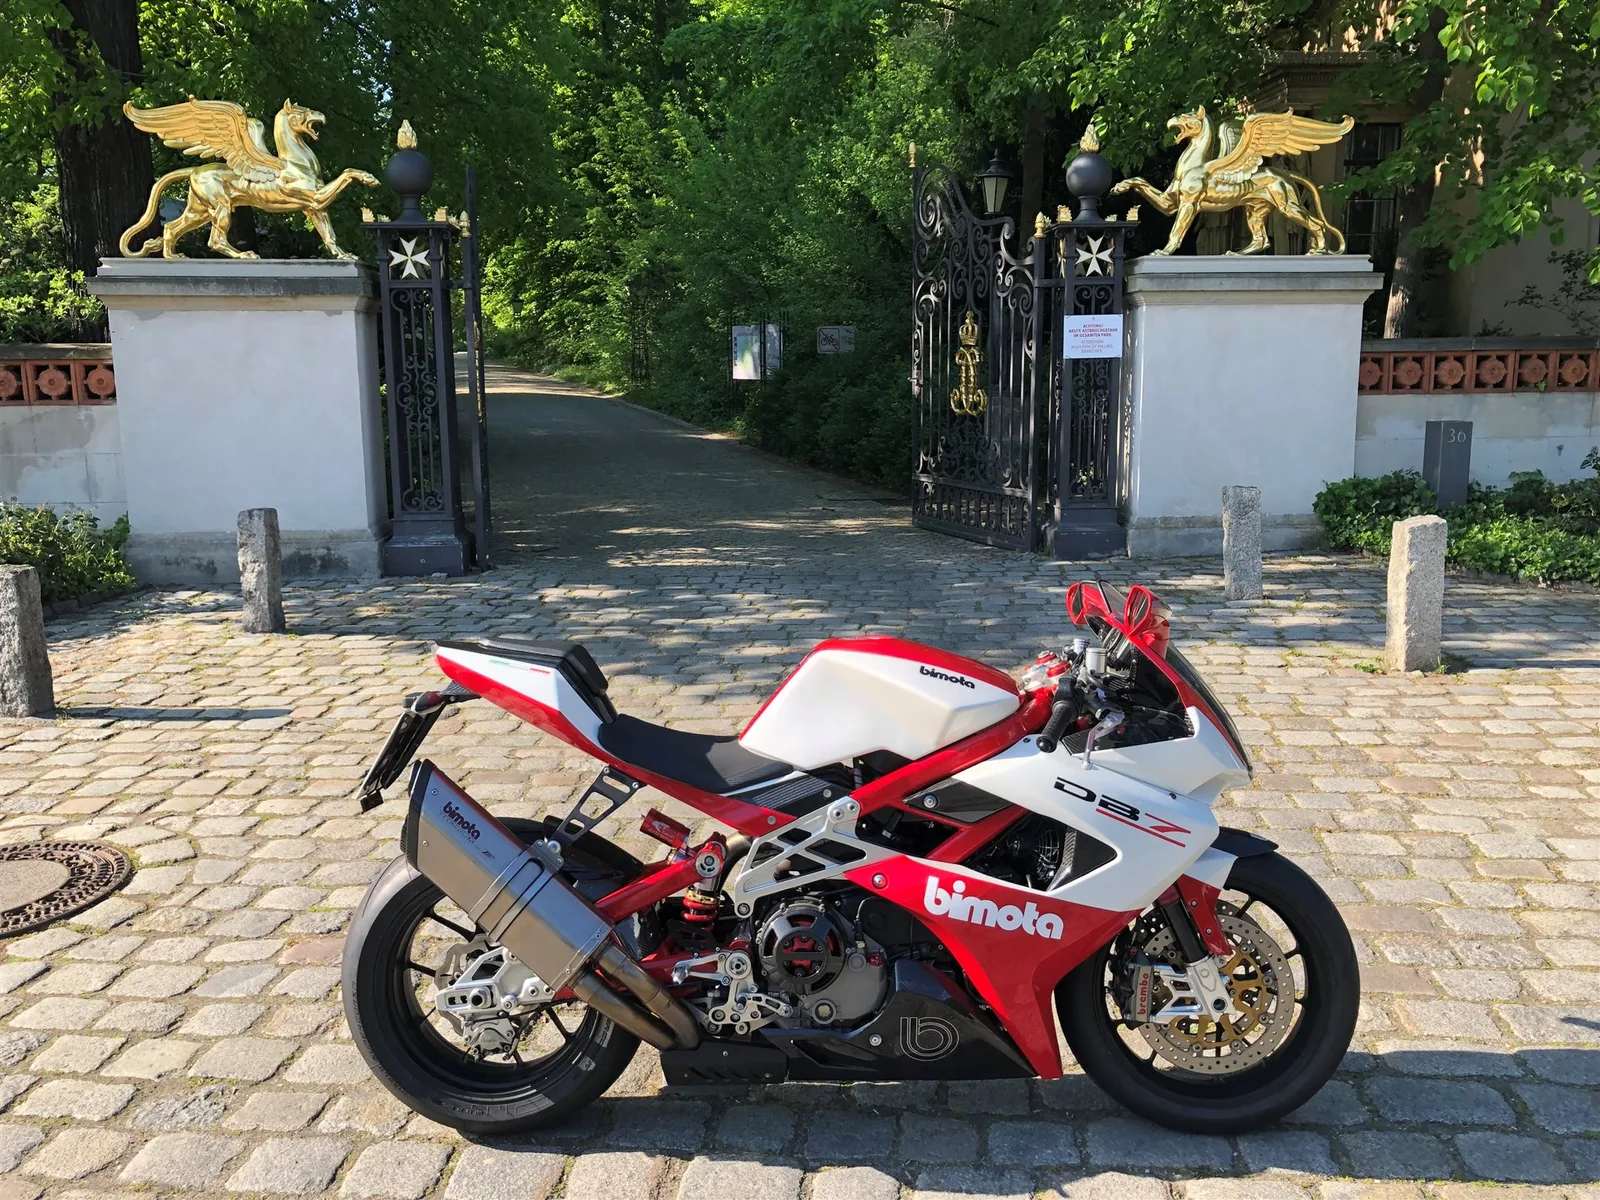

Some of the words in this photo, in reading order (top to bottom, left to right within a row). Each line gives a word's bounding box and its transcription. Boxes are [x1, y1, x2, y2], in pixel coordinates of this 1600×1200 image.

[1447, 428, 1467, 443] 36
[920, 666, 975, 689] bimota
[442, 801, 480, 840] bimota
[1054, 776, 1191, 847] DB7
[923, 875, 1064, 940] bimota
[1137, 973, 1149, 1015] brembo
